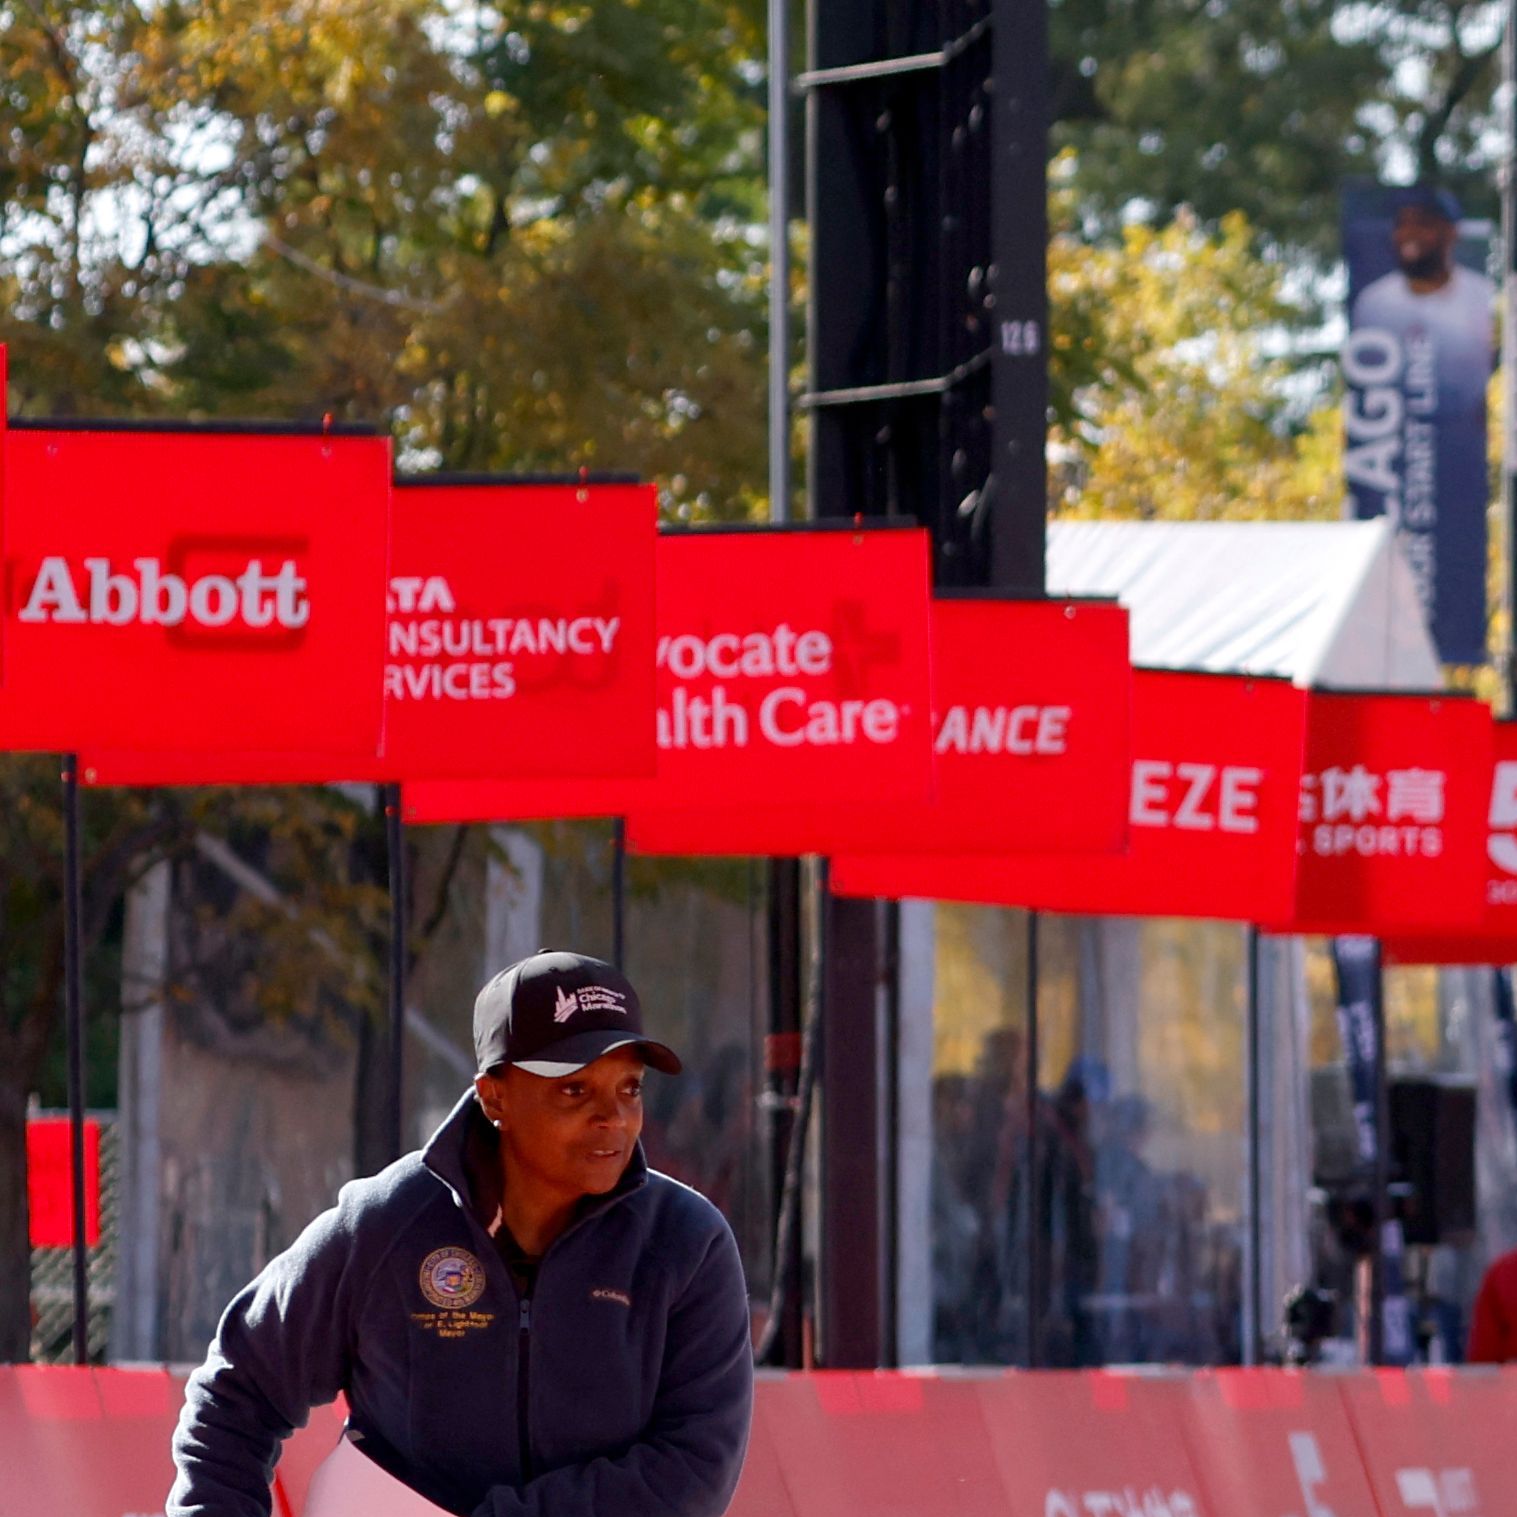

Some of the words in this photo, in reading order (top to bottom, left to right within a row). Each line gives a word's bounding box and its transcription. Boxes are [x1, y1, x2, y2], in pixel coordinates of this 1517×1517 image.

[19, 557, 310, 628] Abbott
[389, 616, 621, 657] NSULTANCY
[759, 686, 899, 748] Care
[1127, 758, 1264, 836] EZE
[1314, 824, 1443, 858] SPORTS
